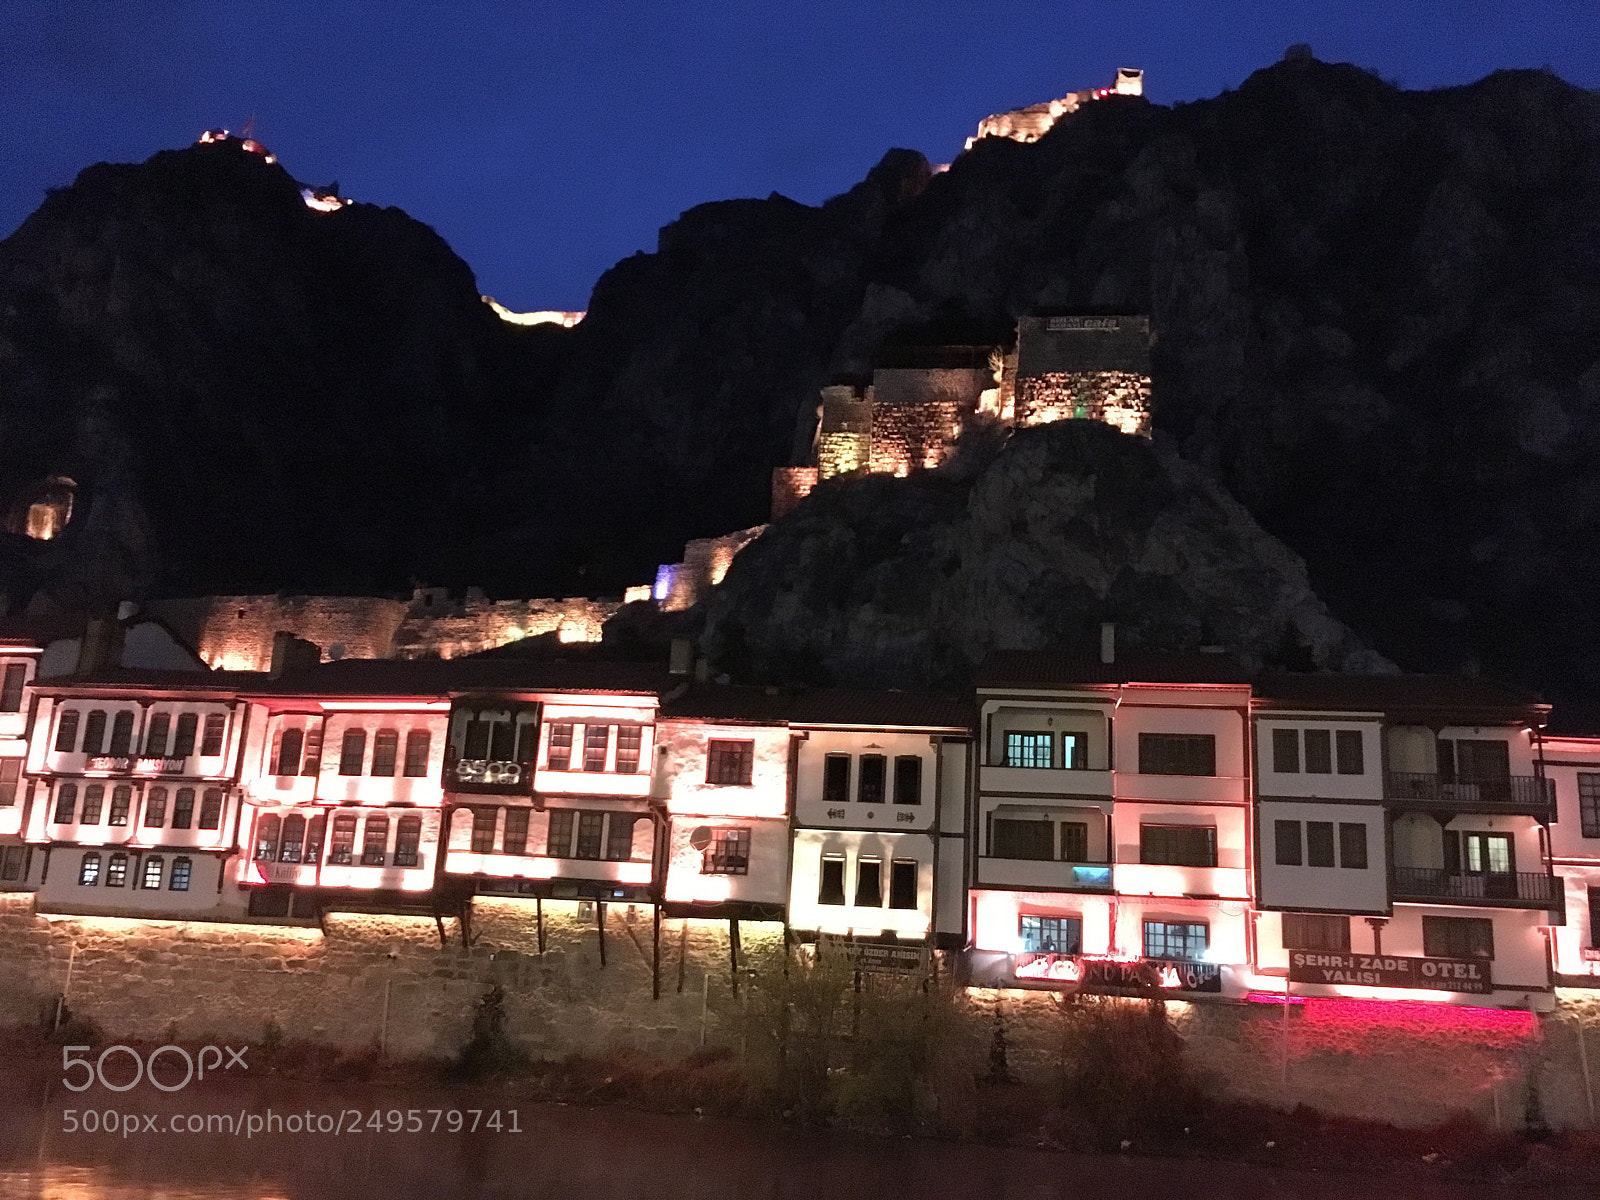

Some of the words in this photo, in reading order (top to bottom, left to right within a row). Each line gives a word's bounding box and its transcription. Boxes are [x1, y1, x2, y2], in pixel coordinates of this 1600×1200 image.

[456, 761, 522, 777] 8500
[1359, 957, 1409, 972] ZADE
[1421, 962, 1482, 979] OTEL
[1322, 969, 1381, 984] YALISI
